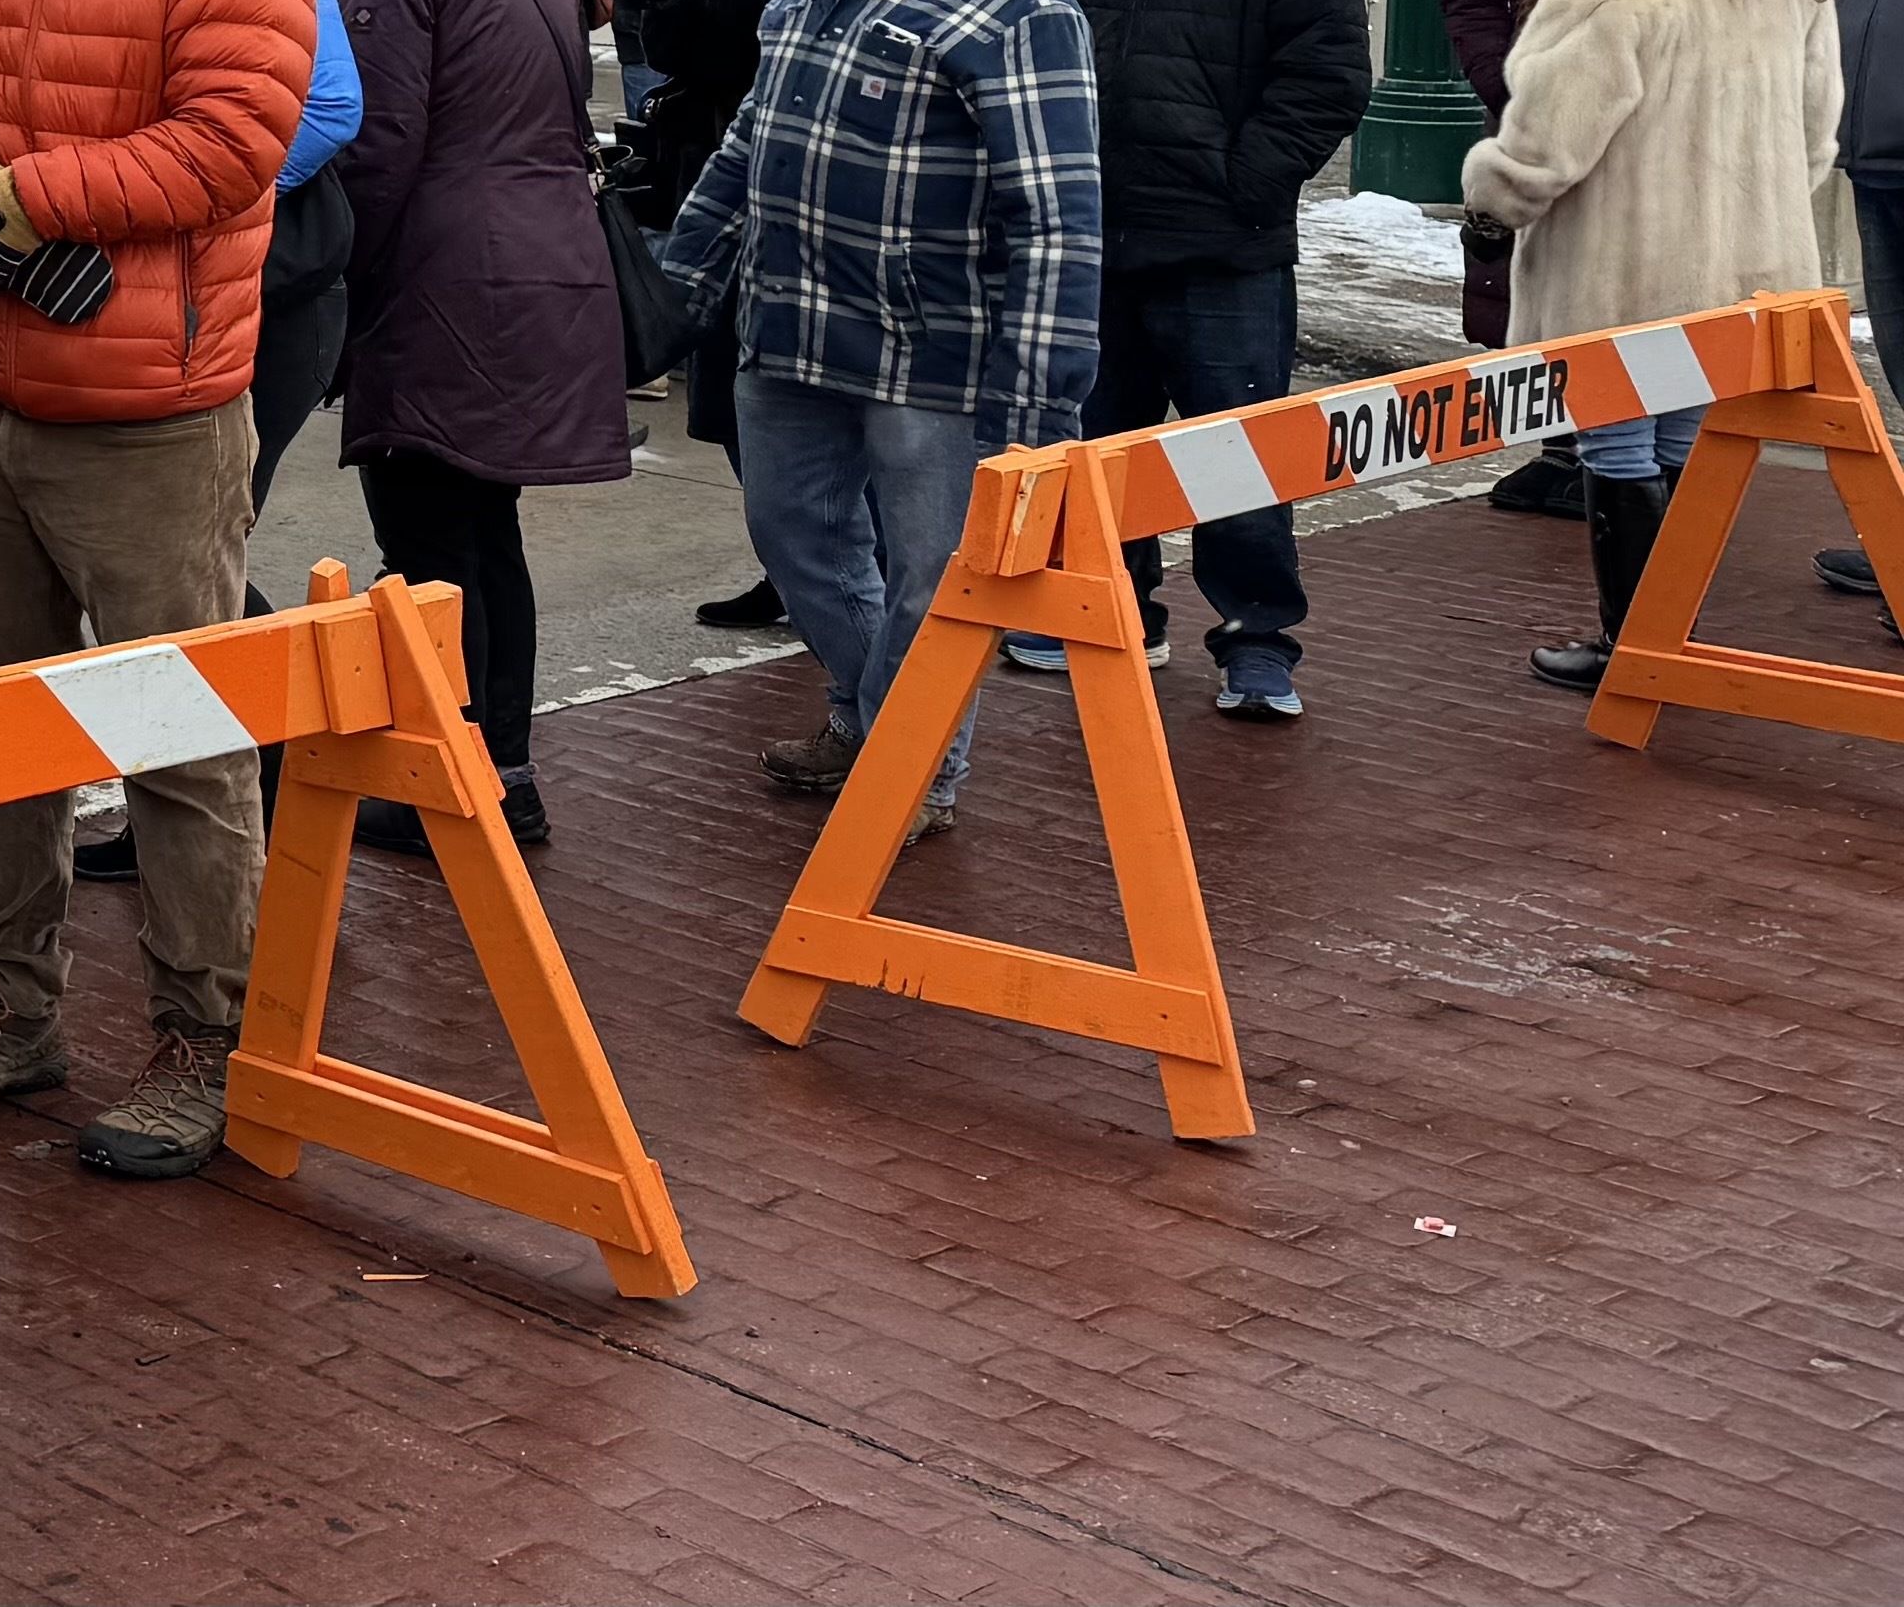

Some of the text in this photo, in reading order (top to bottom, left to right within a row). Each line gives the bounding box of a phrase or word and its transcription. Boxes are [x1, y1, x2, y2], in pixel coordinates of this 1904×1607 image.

[1325, 358, 1568, 482] DO NOT ENTER
